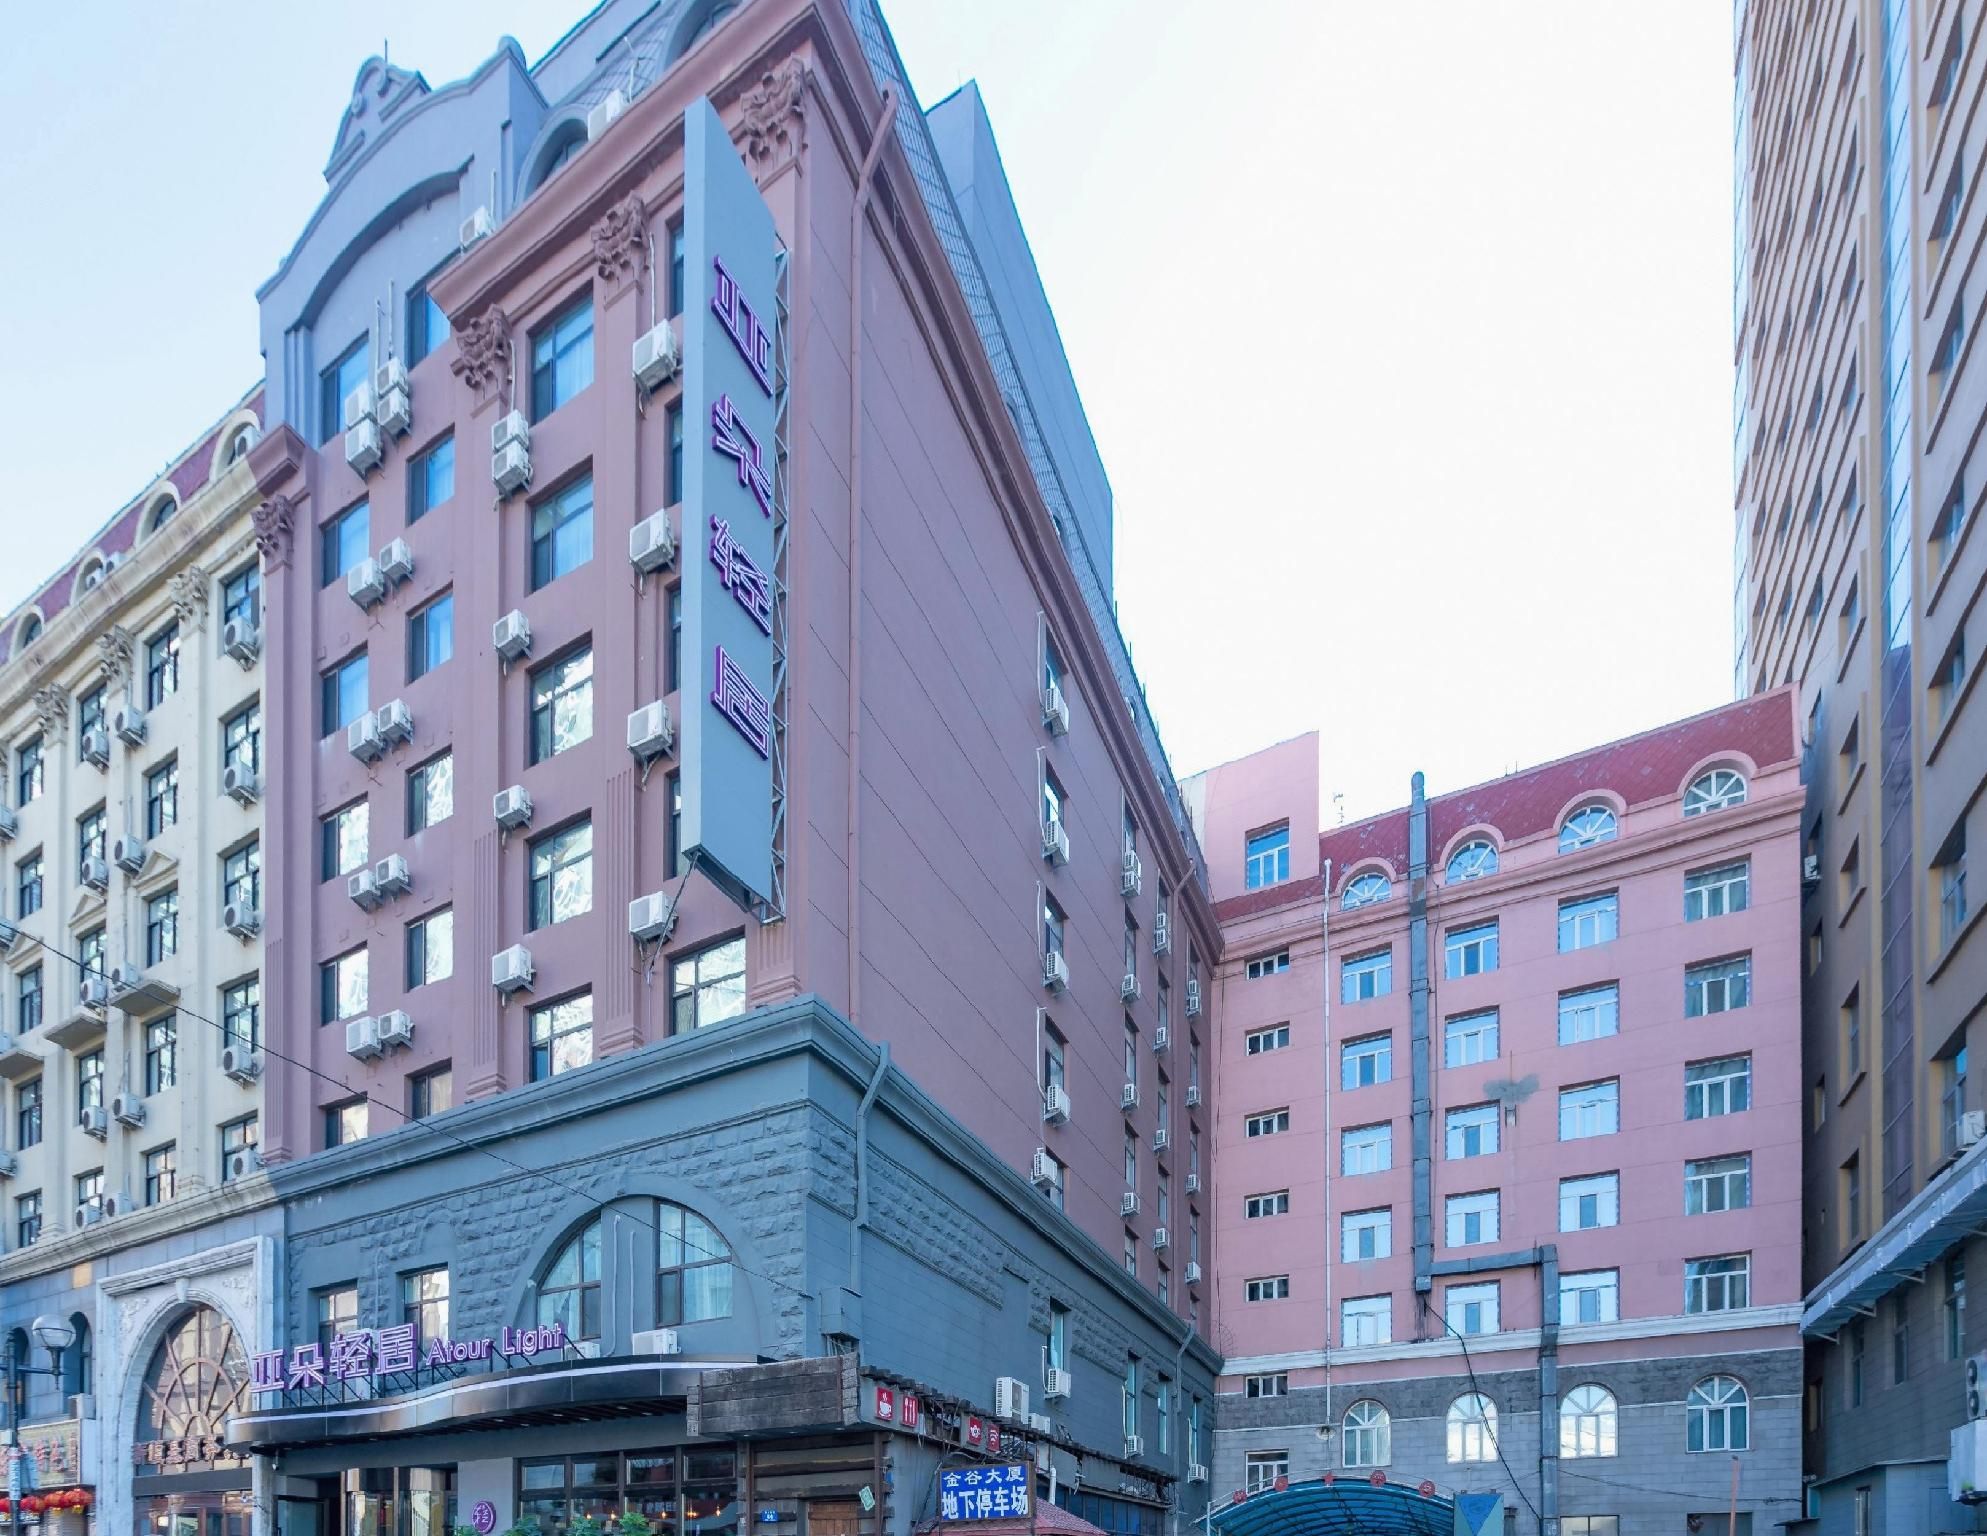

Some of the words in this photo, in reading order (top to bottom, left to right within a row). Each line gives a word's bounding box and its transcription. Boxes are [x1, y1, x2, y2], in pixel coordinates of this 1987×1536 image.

[710, 255, 773, 760] 亚朵轻居
[249, 1323, 417, 1392] 亚朵轻居
[426, 1338, 493, 1366] Atour
[502, 1323, 565, 1355] Light
[942, 1485, 1028, 1519] 地下停车场
[943, 1466, 1024, 1487] 金谷大厦
